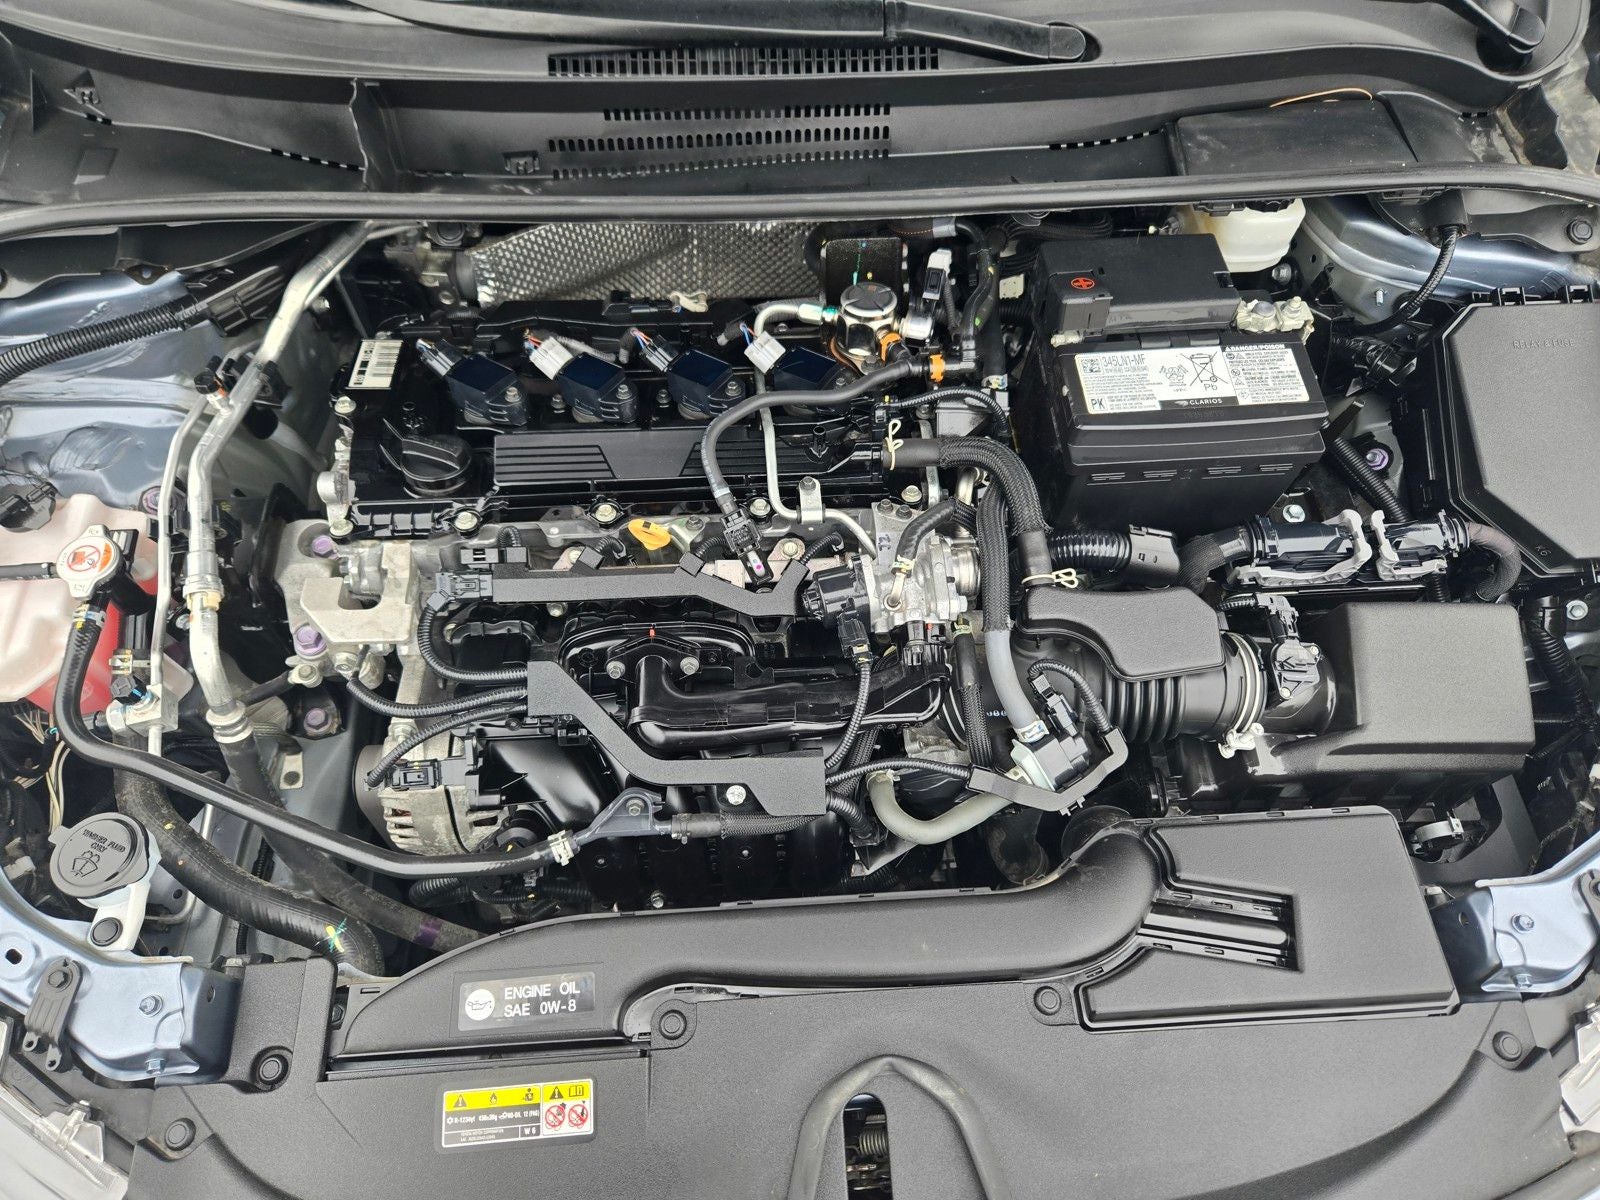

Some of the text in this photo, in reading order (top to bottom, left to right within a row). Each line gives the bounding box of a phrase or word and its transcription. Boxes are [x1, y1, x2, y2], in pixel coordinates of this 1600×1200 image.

[1204, 383, 1218, 391] Pb
[1090, 398, 1106, 410] PK
[1189, 398, 1223, 406] CLARIOS
[504, 981, 581, 1000] ENGINE OIL
[504, 1002, 531, 1018] SAE
